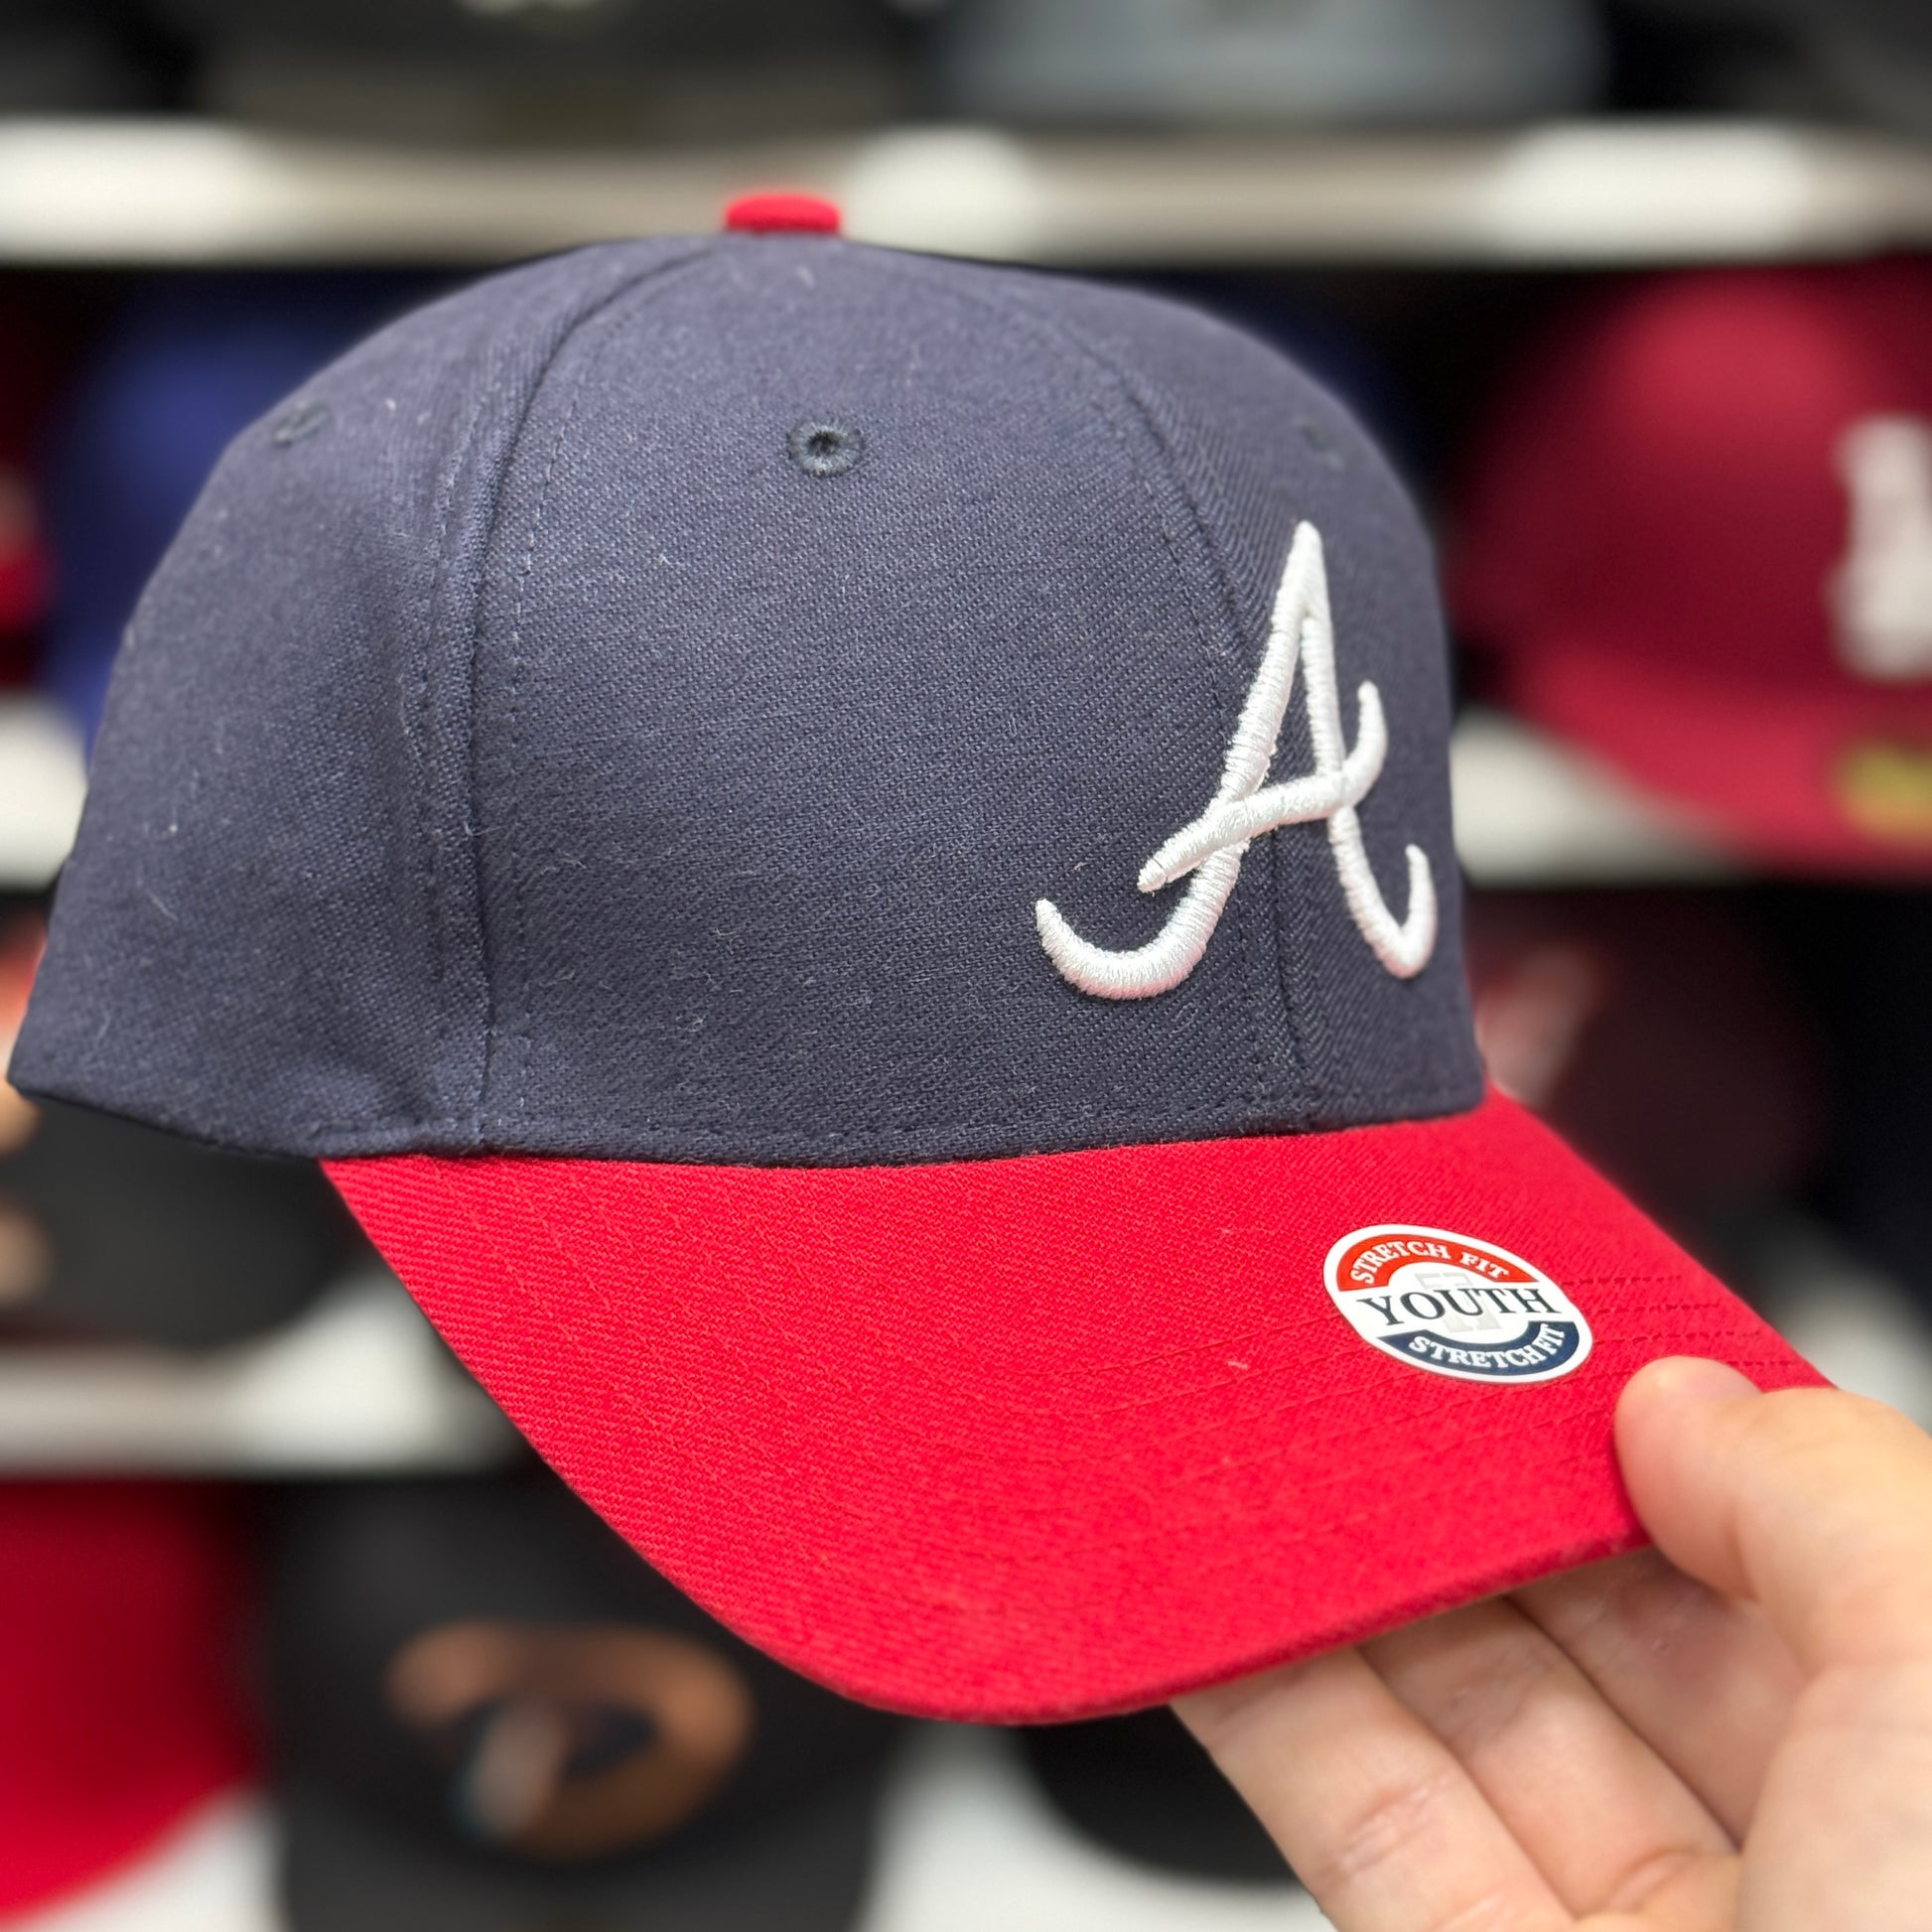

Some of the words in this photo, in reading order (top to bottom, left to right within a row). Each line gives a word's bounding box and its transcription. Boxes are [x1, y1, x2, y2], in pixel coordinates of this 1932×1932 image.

[1035, 520, 1439, 1000] A
[1350, 1240, 1451, 1285] STRETCH
[1459, 1251, 1509, 1280] FIT
[1356, 1288, 1562, 1326] YOUTH
